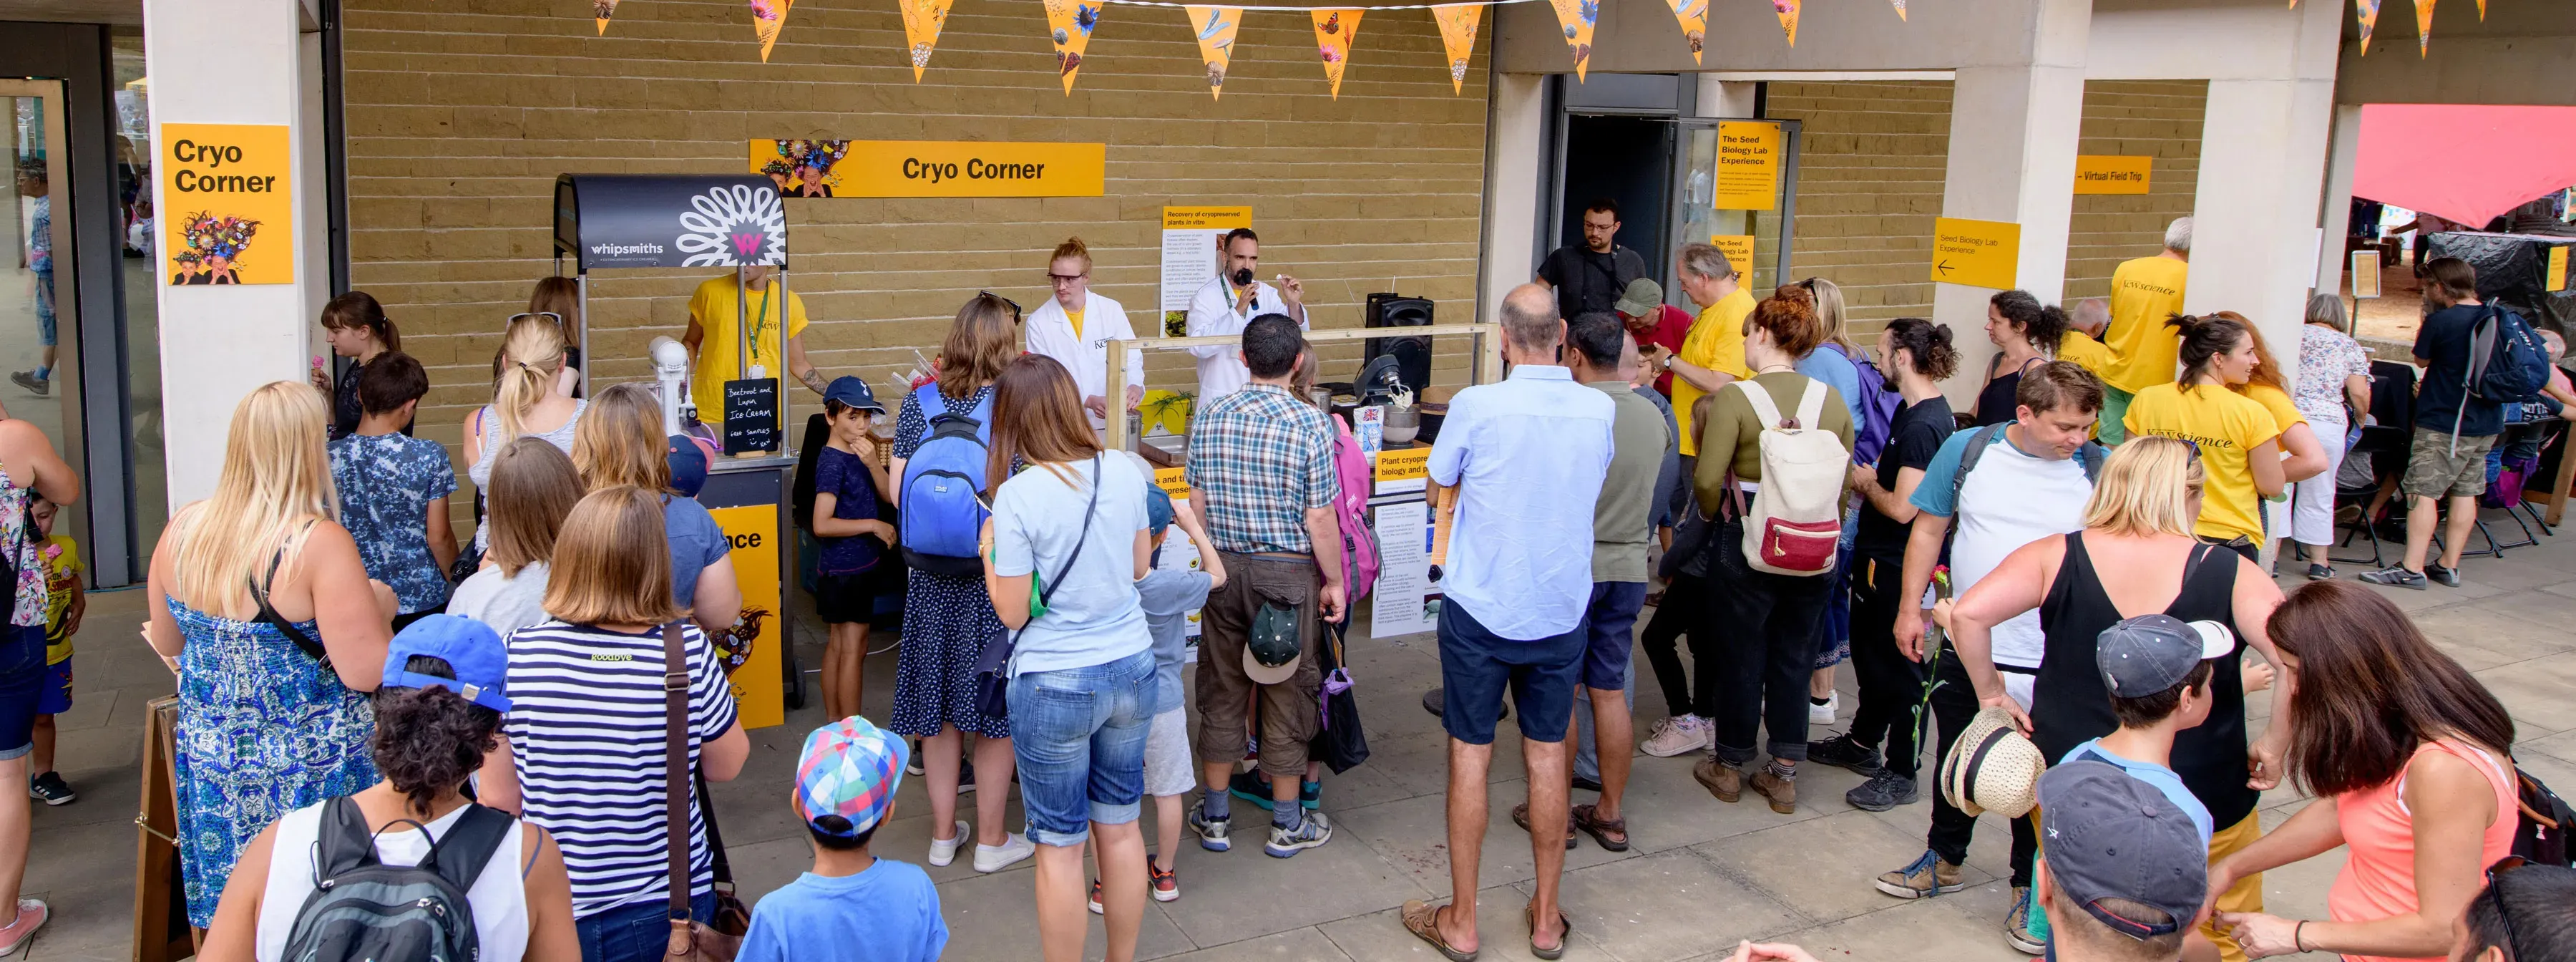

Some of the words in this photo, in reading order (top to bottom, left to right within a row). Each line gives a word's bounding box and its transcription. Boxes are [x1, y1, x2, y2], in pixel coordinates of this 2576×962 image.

[174, 139, 243, 168] Cryo
[1722, 146, 1752, 155] Biology
[1721, 157, 1765, 165] Experience
[902, 157, 958, 184] Cryo
[967, 157, 1045, 180] Corner
[175, 169, 275, 193] Corner
[2084, 171, 2108, 180] Virtual
[2110, 171, 2127, 181] Field
[2129, 171, 2142, 183] Trip
[1940, 234, 1958, 243] Seed
[1959, 235, 1984, 246] Biology
[1985, 238, 1999, 247] Lab
[590, 243, 664, 257] whipsmiths
[1939, 244, 1976, 254] Experience
[727, 387, 757, 397] Beetroot
[737, 397, 757, 406] Lupin
[1381, 457, 1400, 465] Plant
[1381, 467, 1407, 476] biology
[1162, 475, 1177, 484] and
[591, 653, 633, 663] goodbye
